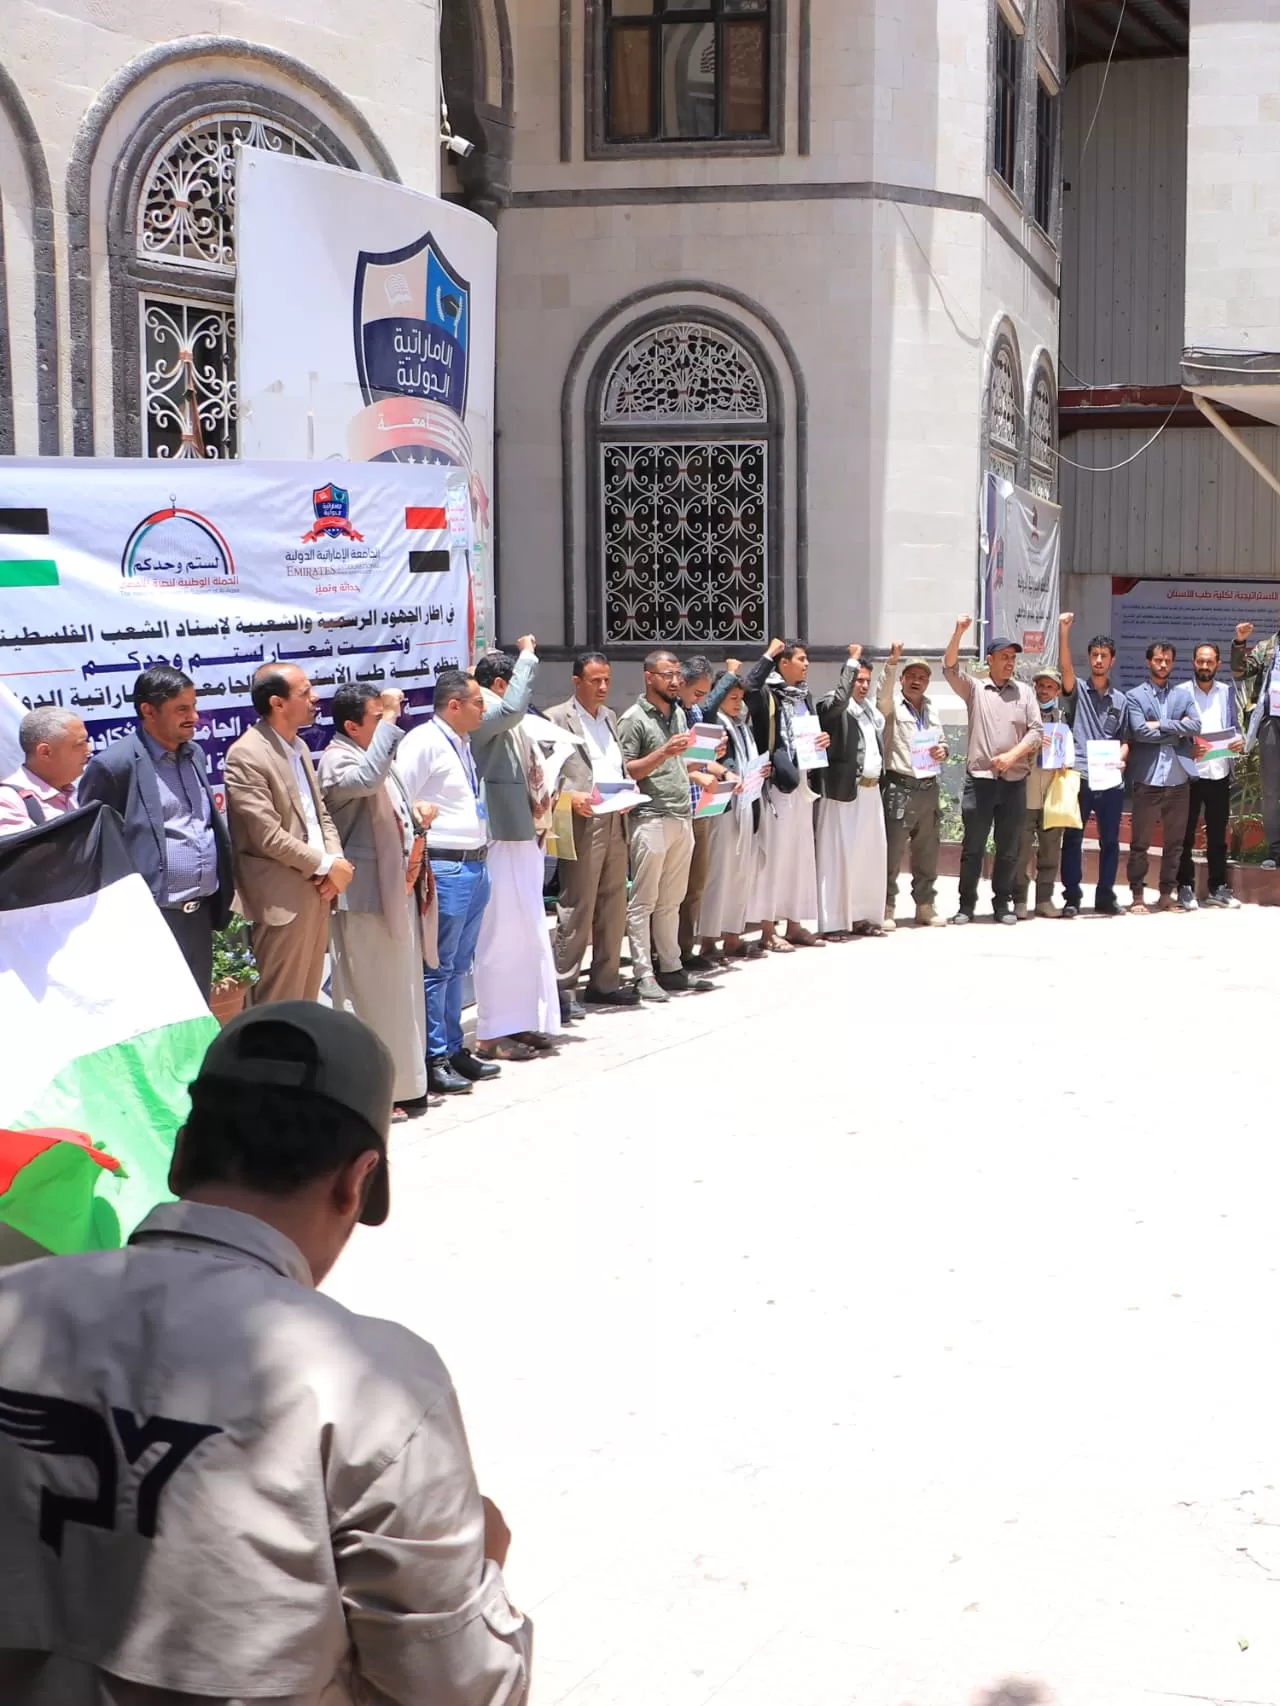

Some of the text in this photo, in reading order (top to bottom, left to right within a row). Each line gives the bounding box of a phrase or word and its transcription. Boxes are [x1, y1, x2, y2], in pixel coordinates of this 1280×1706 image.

[397, 361, 450, 400] الدولية
[133, 556, 219, 574] لستم وحدكم
[285, 549, 315, 563] الدولية
[178, 576, 210, 588] الوطنية
[213, 576, 239, 585] الحملة
[236, 613, 313, 637] والشعبية
[318, 608, 377, 632] الرسمية
[381, 606, 422, 628] الجهود
[425, 604, 443, 625] إطار
[446, 602, 455, 627] في
[100, 620, 170, 645] الشعب
[189, 644, 264, 674] لستم
[271, 637, 333, 663] شعار
[82, 651, 183, 682] وحدكم
[356, 664, 385, 683] طب
[390, 658, 430, 681] كلية
